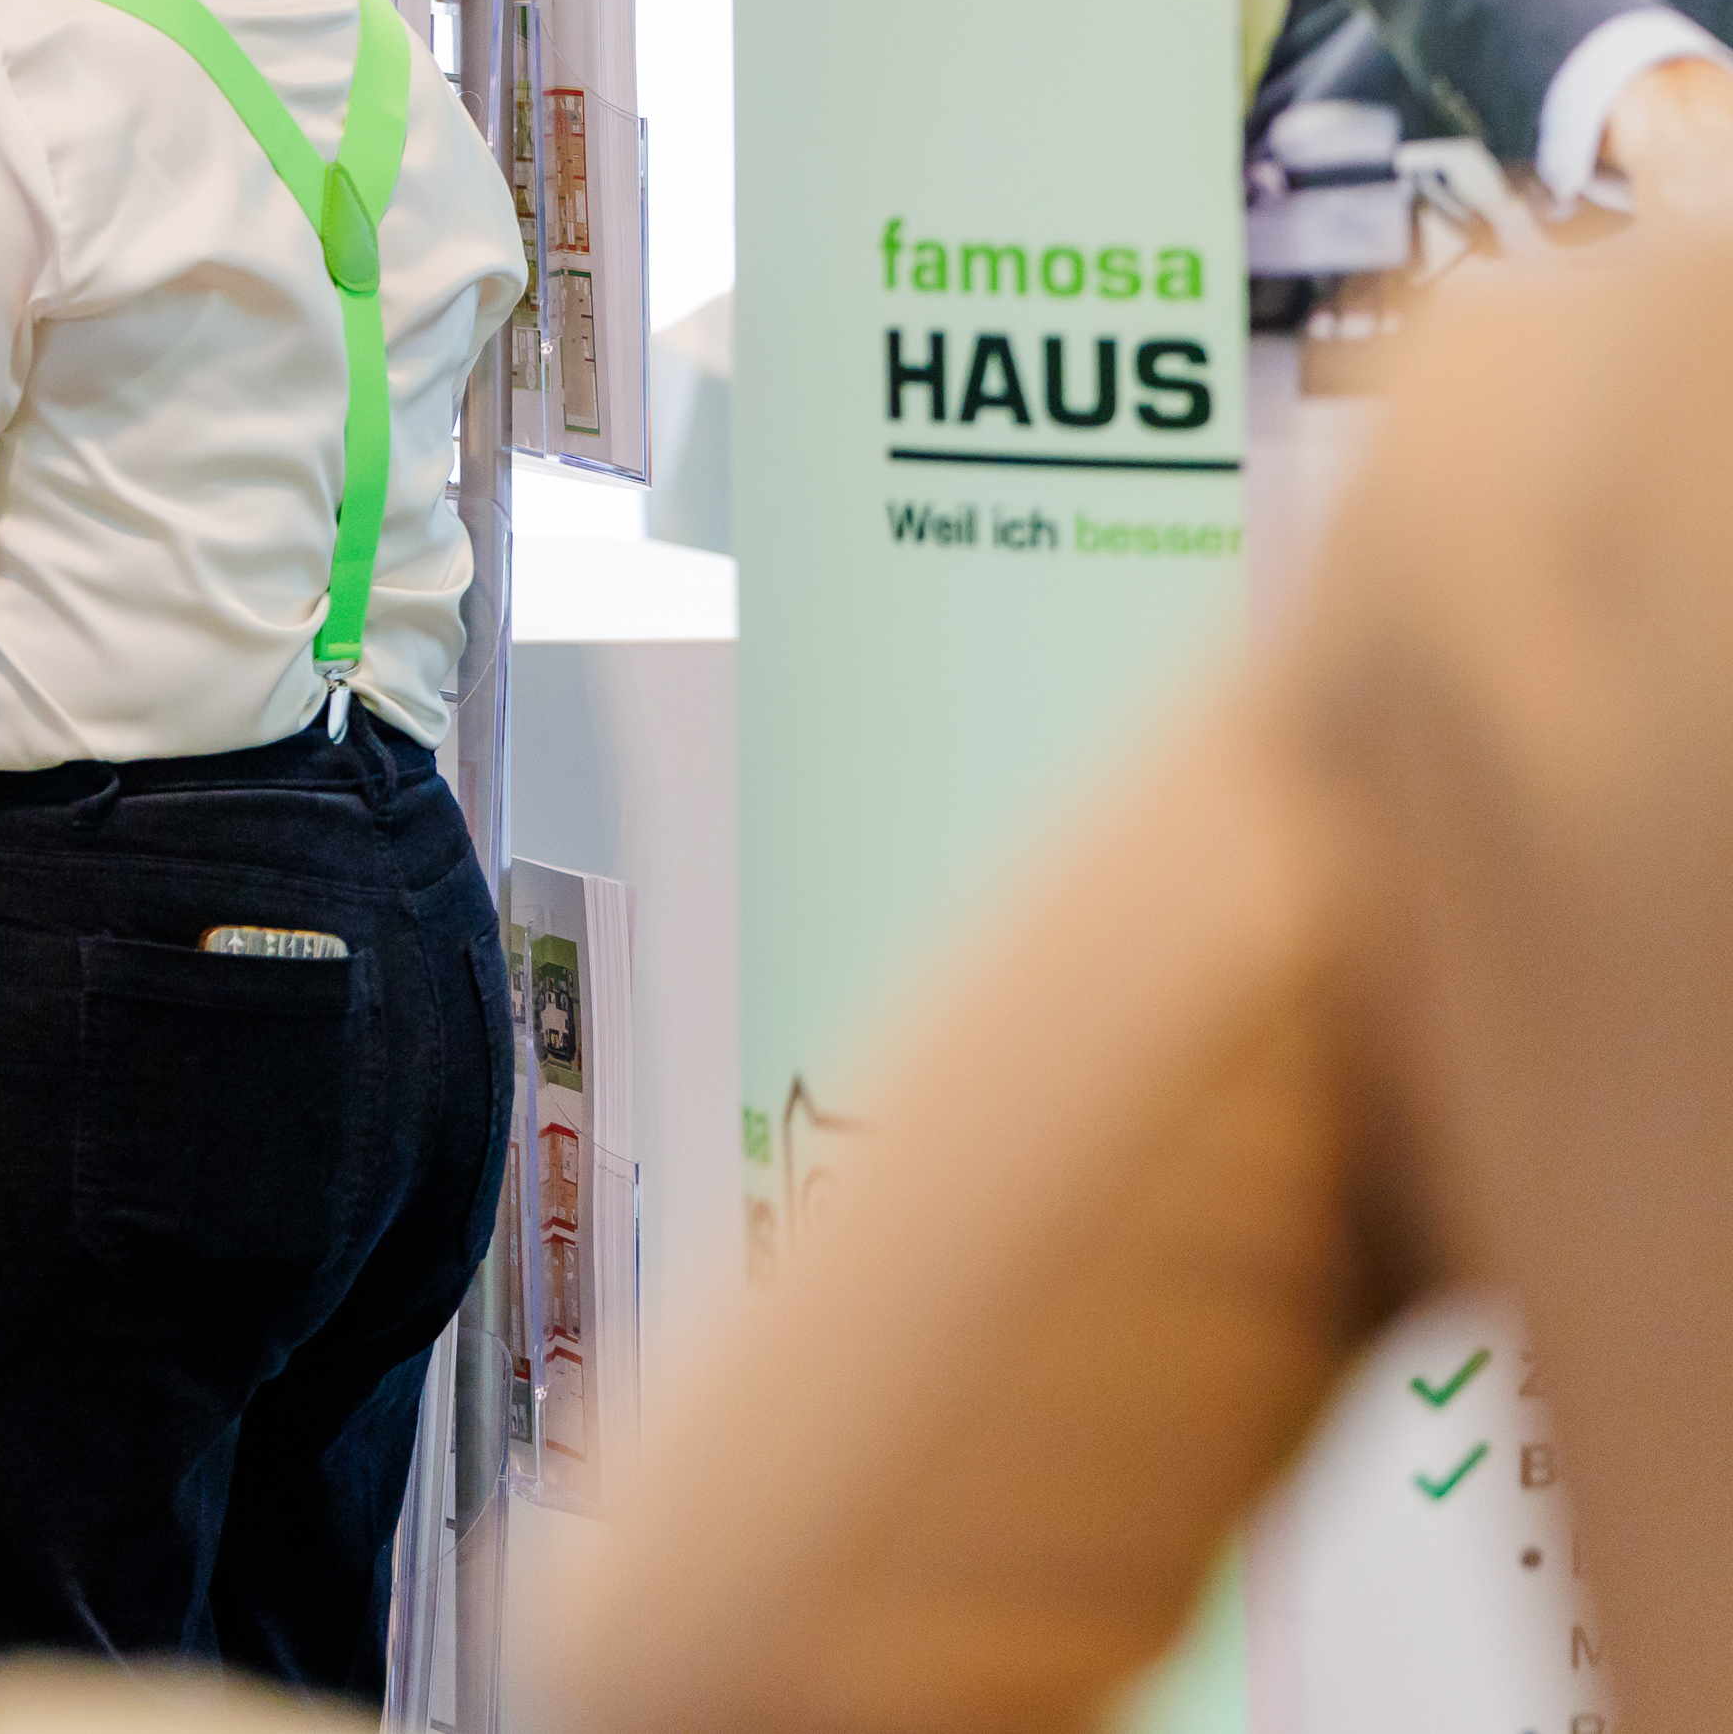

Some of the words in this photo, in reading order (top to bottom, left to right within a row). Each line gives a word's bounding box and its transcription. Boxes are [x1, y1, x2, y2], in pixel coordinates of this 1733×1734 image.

[881, 216, 1204, 303] famosa
[885, 327, 1212, 432] HAUS
[887, 500, 978, 550] Weil
[990, 500, 1059, 553] ich
